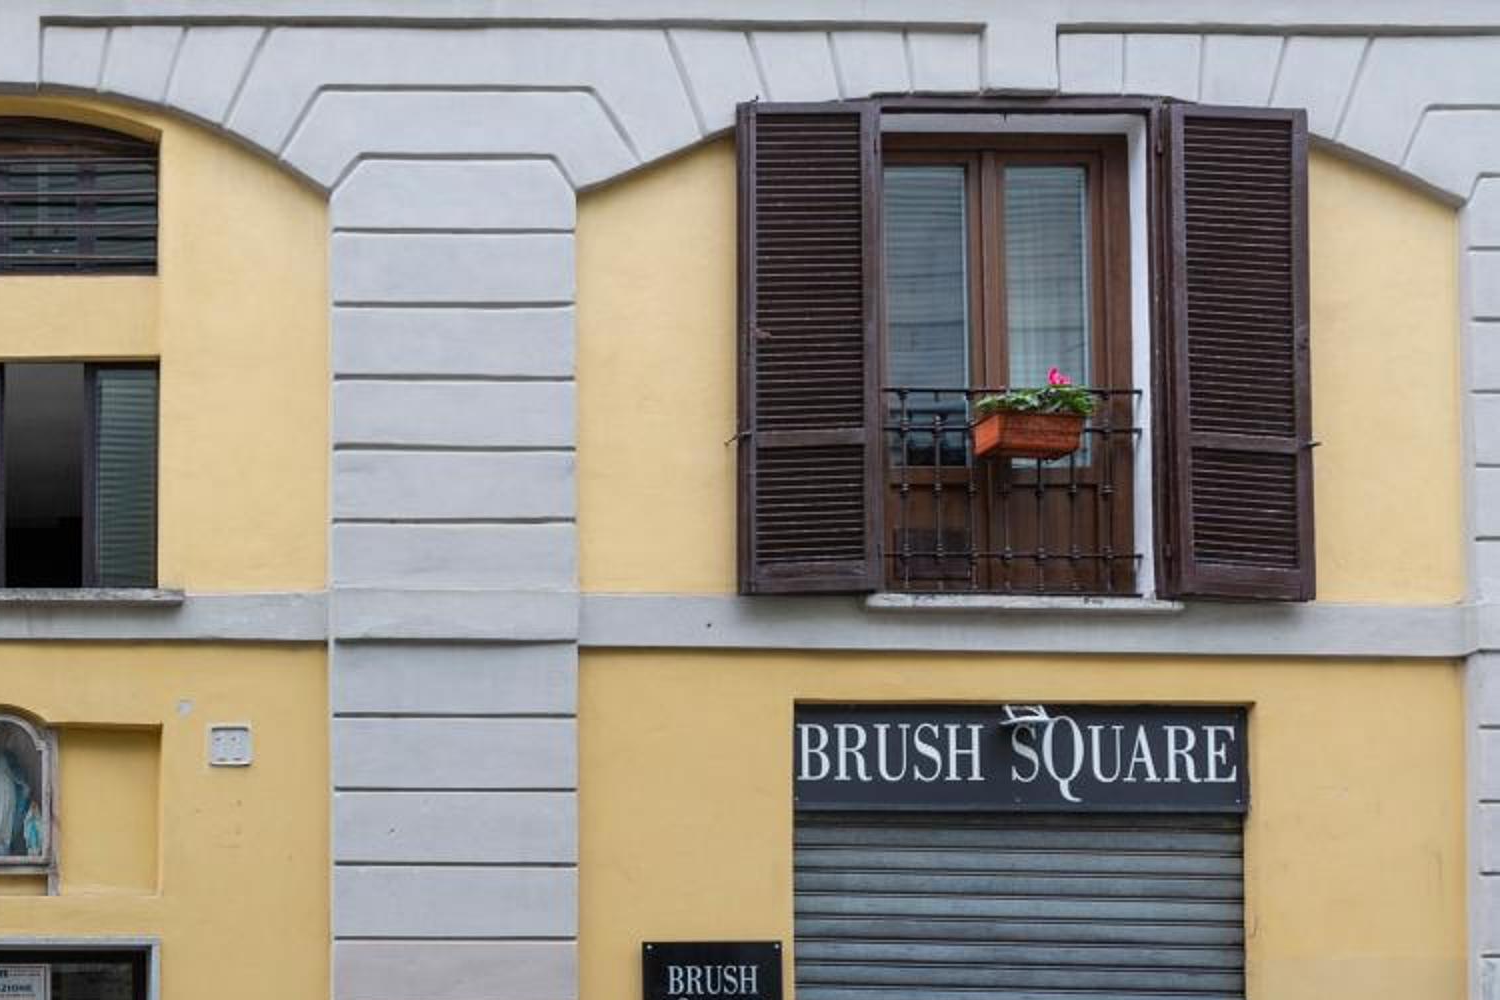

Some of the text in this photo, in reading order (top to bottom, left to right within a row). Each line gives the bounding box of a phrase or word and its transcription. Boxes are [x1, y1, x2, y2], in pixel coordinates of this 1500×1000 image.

[796, 716, 1238, 803] BRUSH SQUARE
[667, 964, 758, 995] BRUSH
